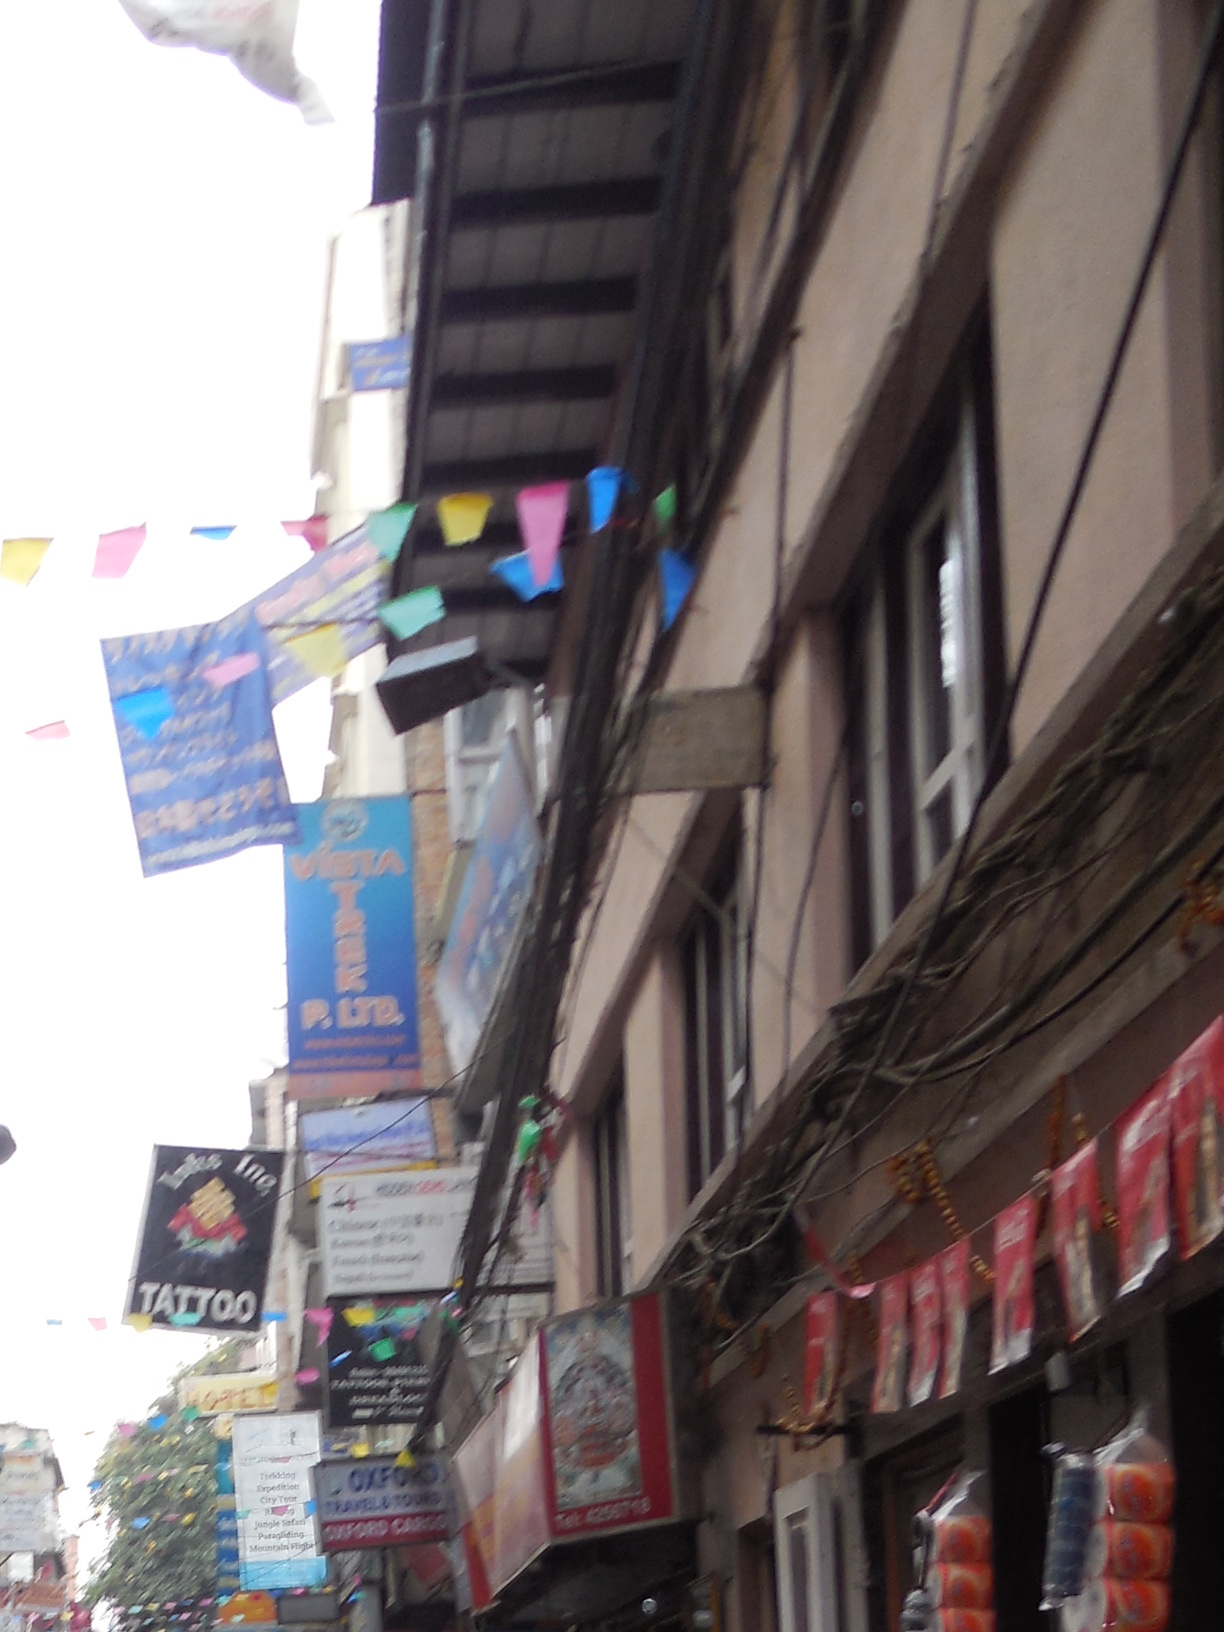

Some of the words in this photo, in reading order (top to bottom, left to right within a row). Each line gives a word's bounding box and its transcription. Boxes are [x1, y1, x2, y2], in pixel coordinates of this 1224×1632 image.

[138, 1281, 258, 1325] TATTOO
[259, 1471, 297, 1482] Trekking
[256, 1483, 300, 1493] Expedition
[260, 1495, 278, 1504] City
[278, 1494, 298, 1502] Tour
[254, 1519, 280, 1529] Jungle
[281, 1518, 306, 1526] Safari
[258, 1530, 305, 1540] Paragliding
[323, 1521, 388, 1542] OXFORD
[249, 1543, 289, 1552] Mountain
